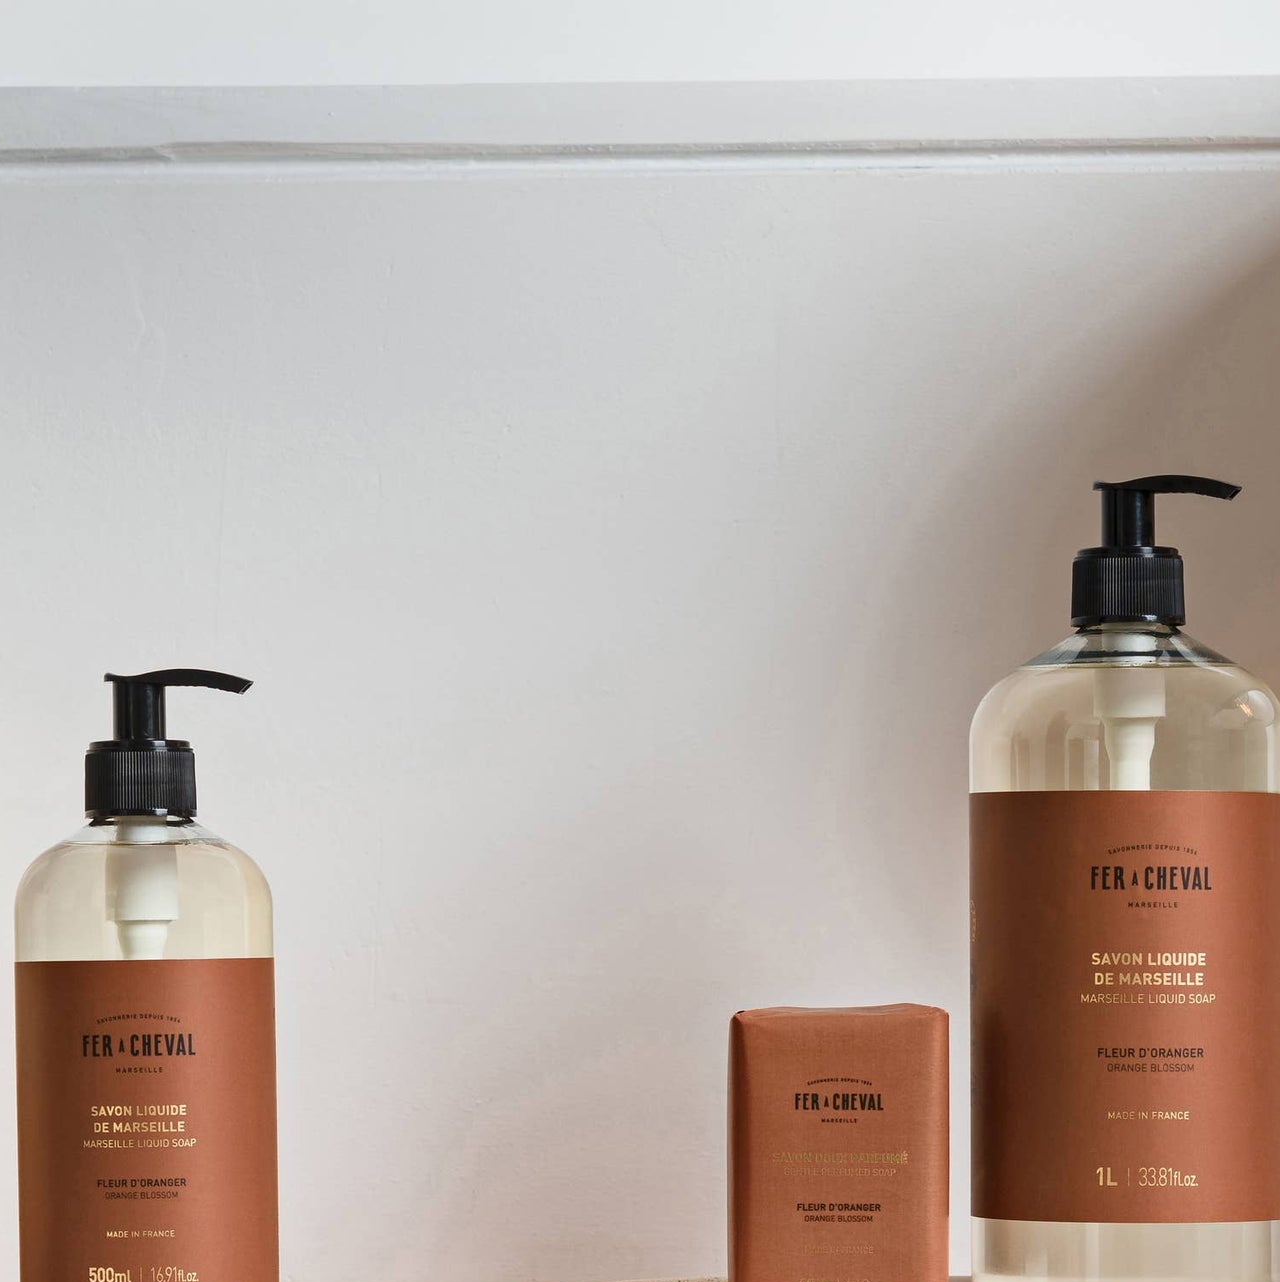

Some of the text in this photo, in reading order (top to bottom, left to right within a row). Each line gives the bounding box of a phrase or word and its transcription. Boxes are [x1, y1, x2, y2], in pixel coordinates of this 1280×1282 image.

[1155, 844, 1180, 852] DEPUIS
[1091, 866, 1126, 891] FER
[1144, 866, 1212, 891] CHEVAL
[1127, 901, 1178, 909] MARSEILLE
[1091, 952, 1207, 967] SAVON LIQUIDE
[1094, 972, 1204, 986] DE MARSEILLE
[1080, 993, 1216, 1005] MARSEILLE LIQUID SOAP
[82, 1034, 114, 1057] FER
[129, 1033, 197, 1057] CHEVAL
[1097, 1047, 1204, 1059] FLEUR D'ORANGER
[115, 1066, 164, 1074] MARSEILLE
[1106, 1063, 1195, 1073] ORANGE BLOSSOM
[794, 1092, 820, 1111] FER
[832, 1092, 885, 1111] CHEVAL
[91, 1104, 187, 1117] SAVON LIQUIDE
[1107, 1111, 1190, 1121] MADE IN FRANCE
[93, 1120, 185, 1133] DE MARSEILLE
[82, 1137, 197, 1149] MARSEILLE LIQUID SOAP
[97, 1177, 187, 1188] FLEUR D'ORANGER
[1095, 1166, 1118, 1187] 1L
[104, 1190, 179, 1200] ORANGE BLOSSOM
[796, 1202, 882, 1212] FLEUR D'ORANGER
[803, 1214, 874, 1223] ORANGE BLOSSOM
[106, 1229, 175, 1239] MADE IN FRANCE
